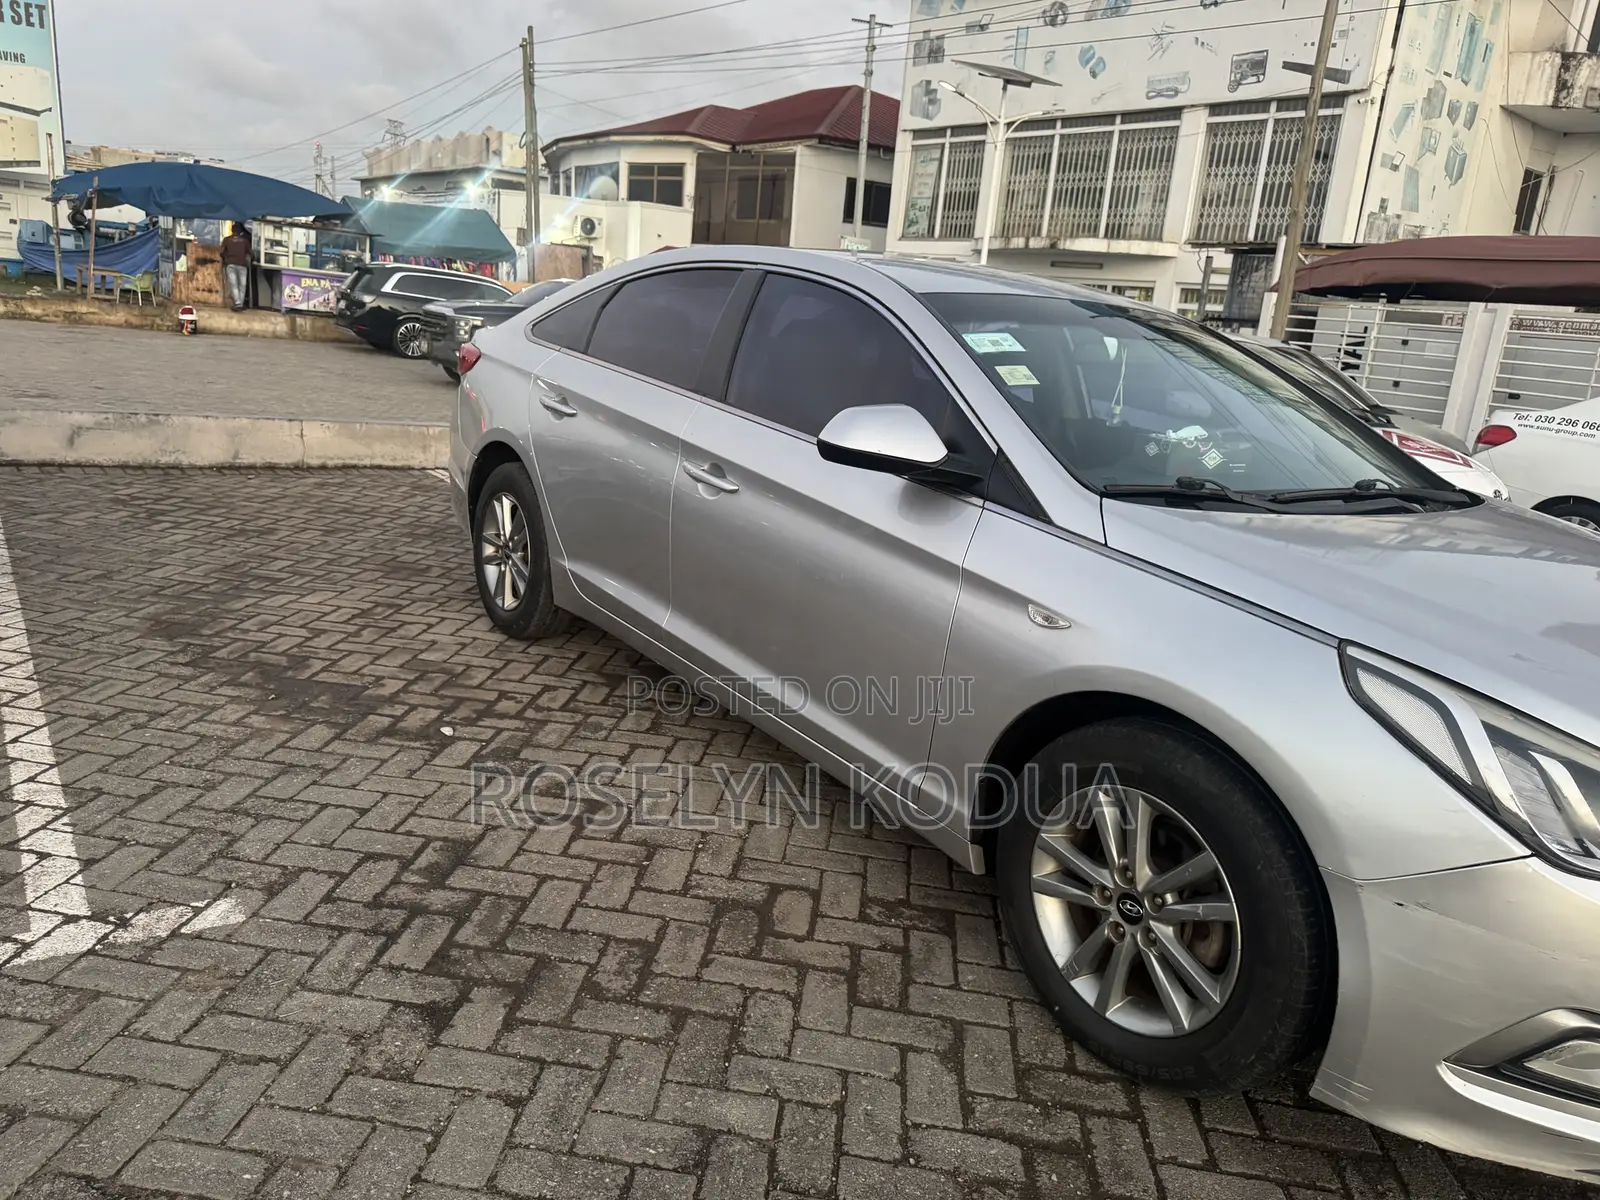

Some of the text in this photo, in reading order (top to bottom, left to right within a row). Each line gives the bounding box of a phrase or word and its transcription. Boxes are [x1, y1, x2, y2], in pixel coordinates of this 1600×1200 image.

[9, 0, 46, 29] SET
[1522, 319, 1600, 330] www.genma
[1513, 412, 1532, 422] Tel:
[1534, 415, 1556, 424] 030
[1557, 417, 1580, 427] 296
[1518, 423, 1596, 438] www.sunu-group.com
